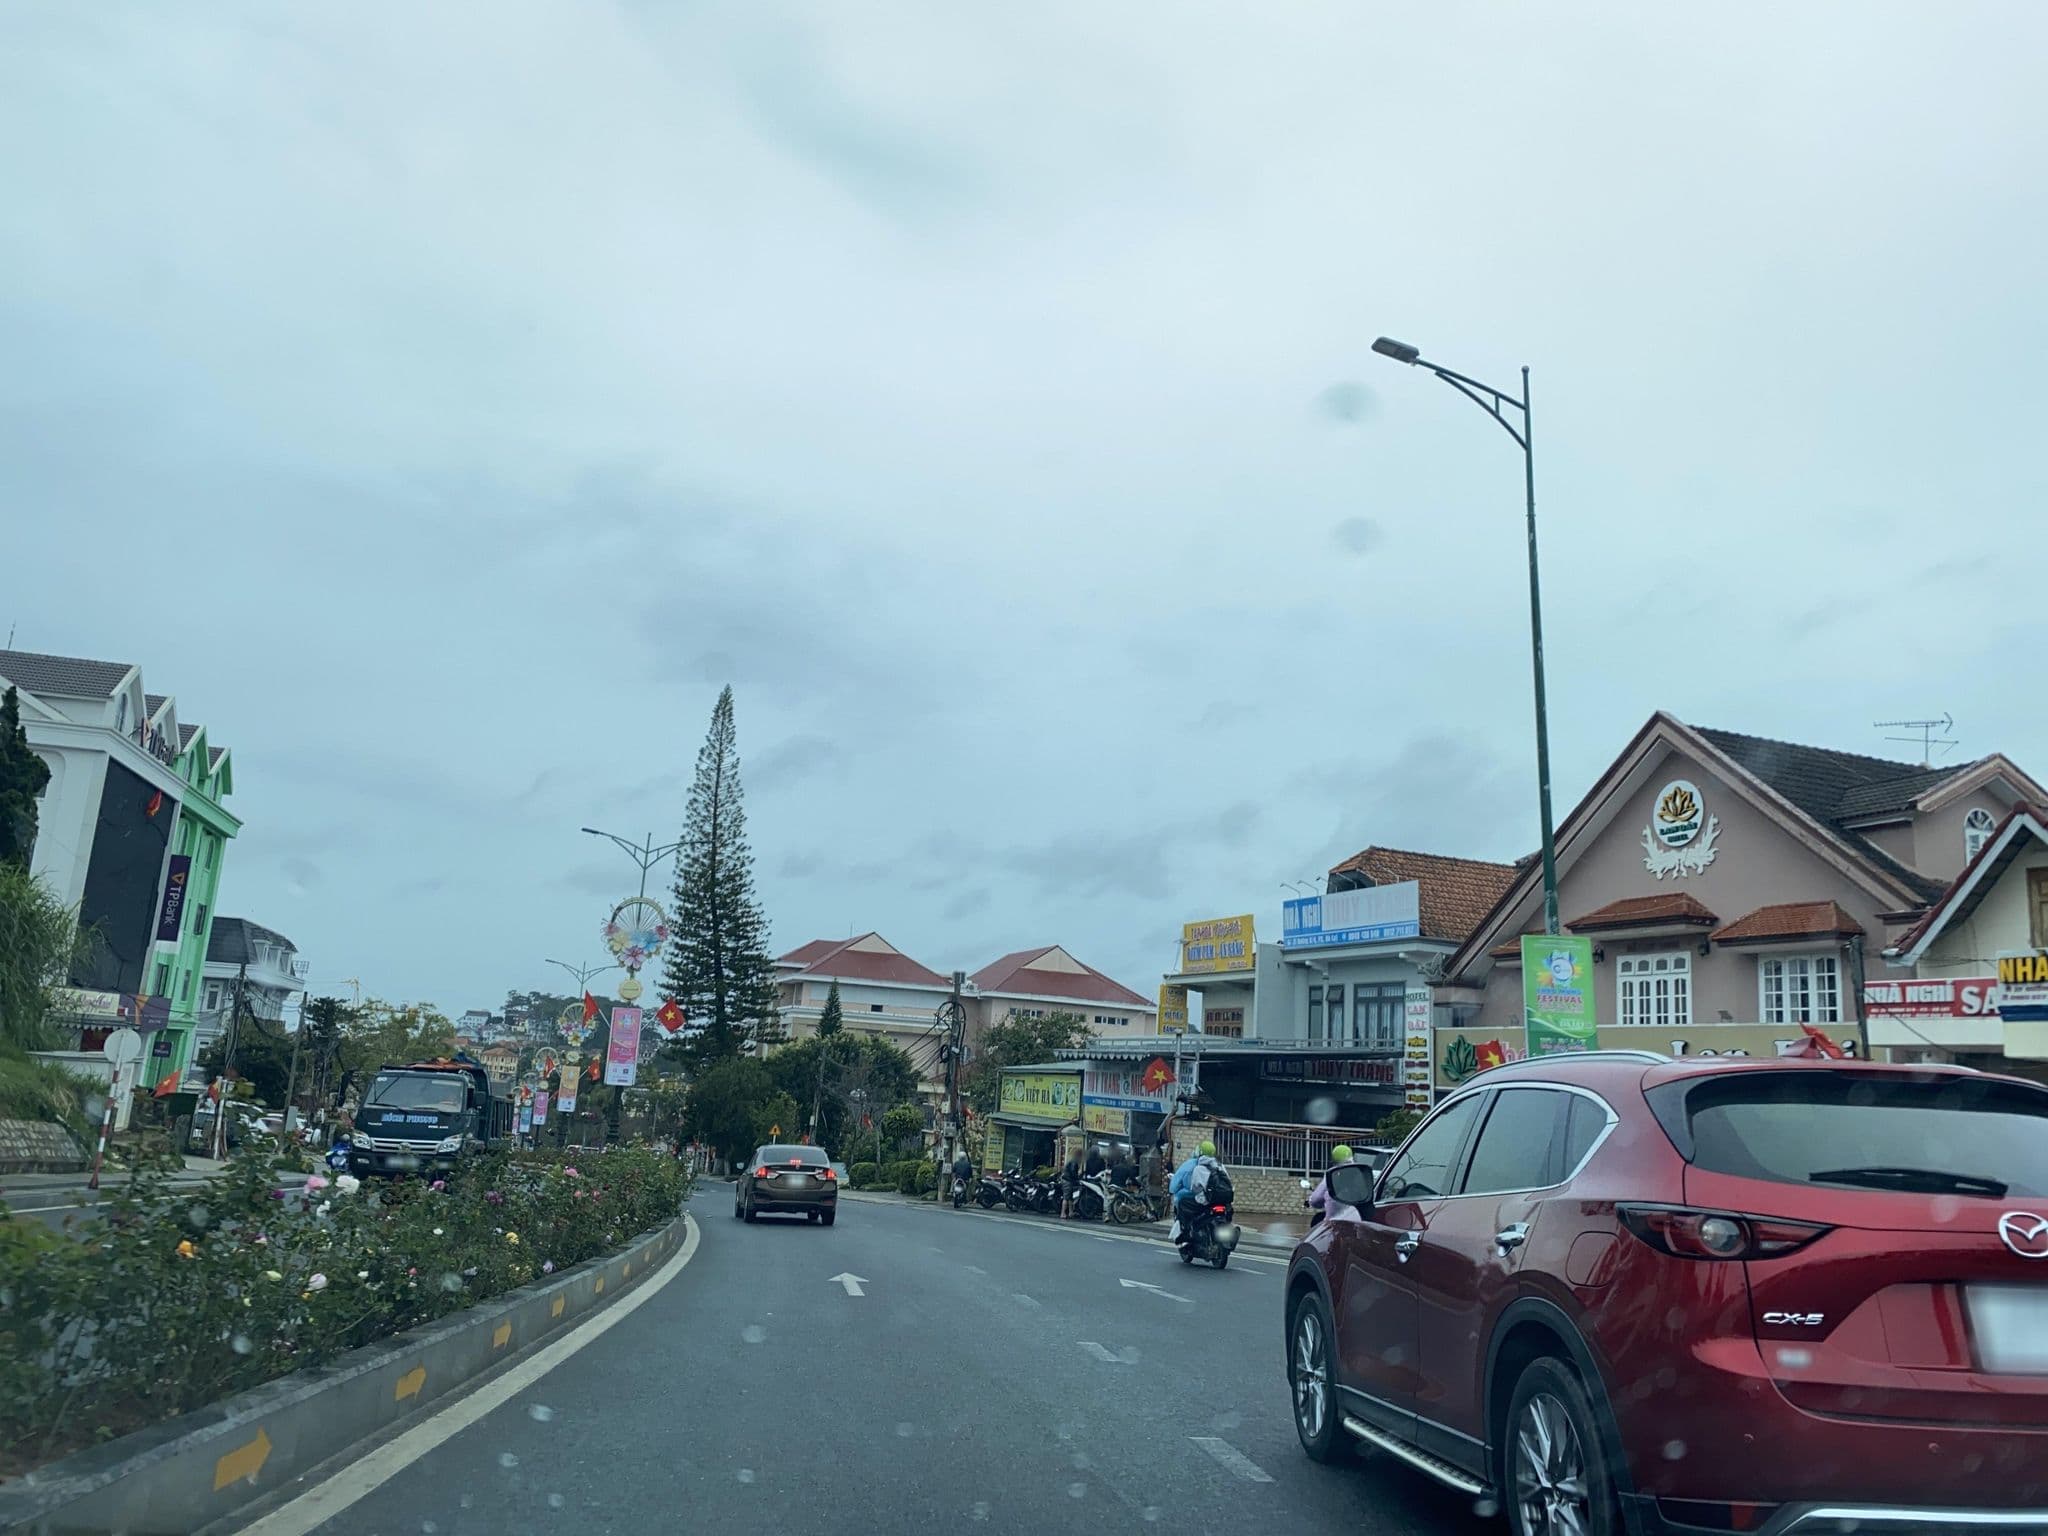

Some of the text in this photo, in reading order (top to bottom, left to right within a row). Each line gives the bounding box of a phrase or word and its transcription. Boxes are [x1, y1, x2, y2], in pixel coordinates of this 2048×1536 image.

[163, 886, 181, 925] TPBank
[1405, 991, 1428, 1001] HOTEL
[1537, 994, 1583, 1004] FESTIVAL
[1763, 1312, 1825, 1325] CX-5
